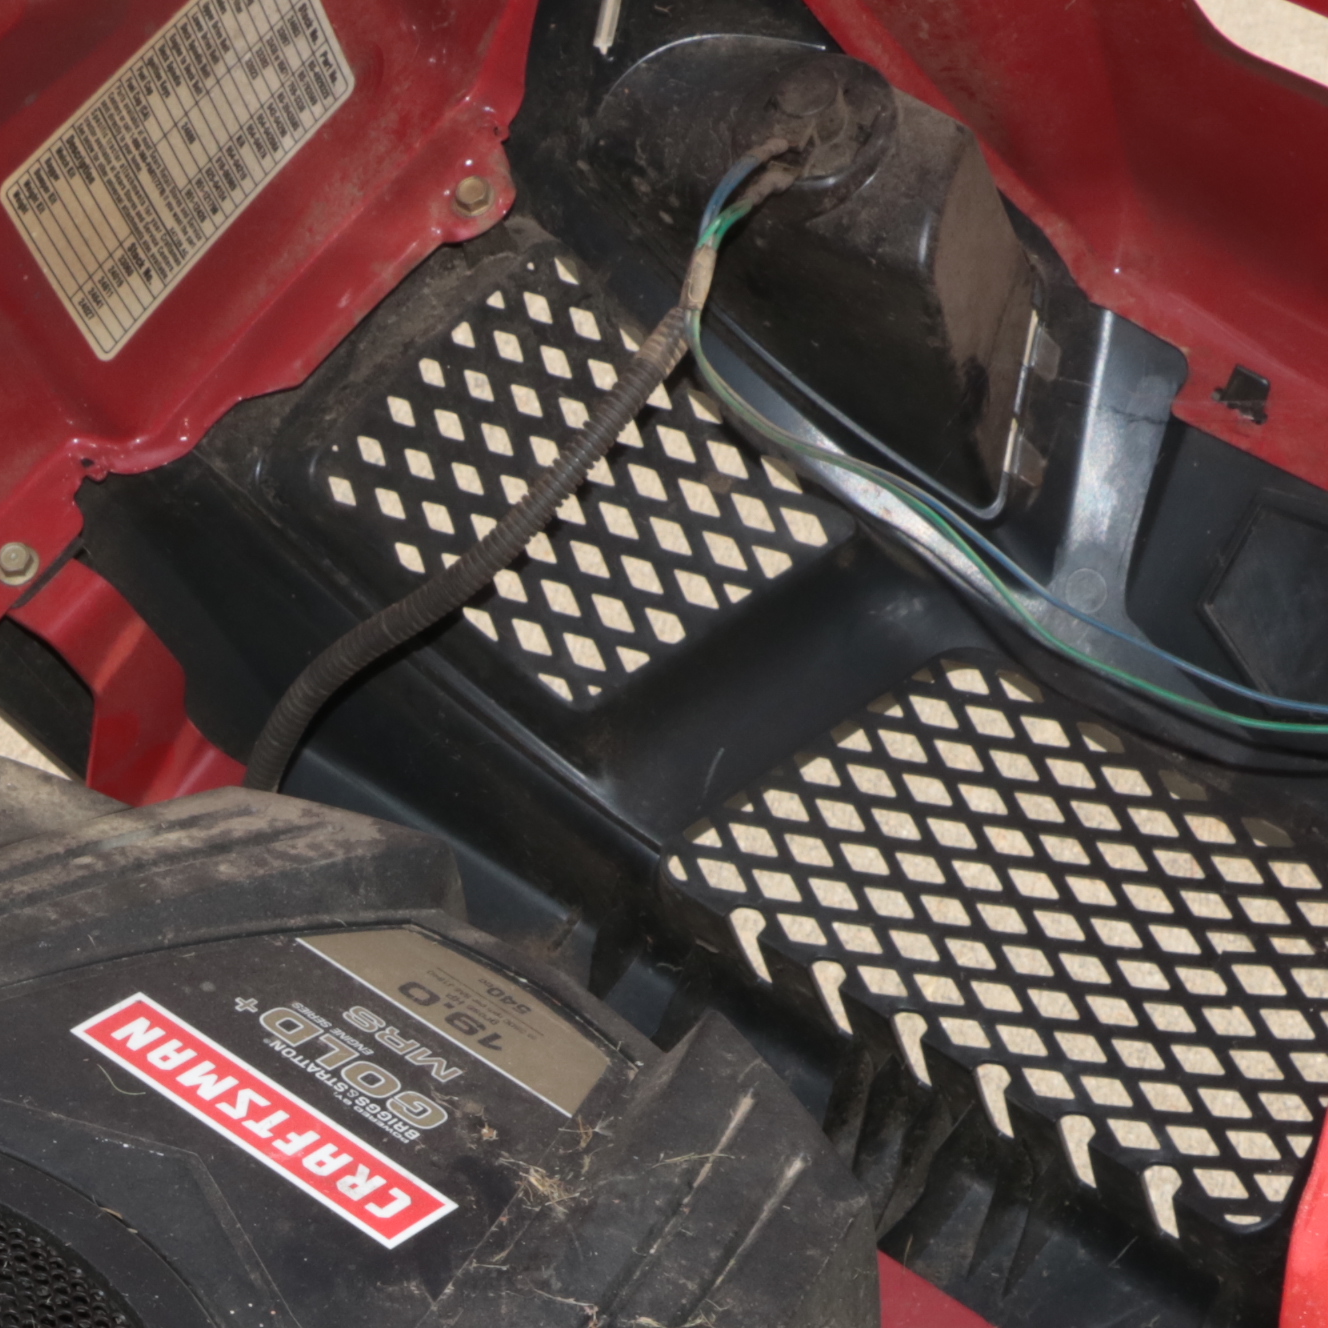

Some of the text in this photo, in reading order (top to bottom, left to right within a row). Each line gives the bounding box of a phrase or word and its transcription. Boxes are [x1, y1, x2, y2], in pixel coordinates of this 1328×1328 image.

[190, 10, 221, 66] Lower Drive Belt
[211, 19, 225, 40] Drive
[219, 36, 231, 54] Belt
[297, 1, 321, 46] Stock No.
[157, 43, 183, 88] Deck Spindle
[167, 32, 185, 59] Engine
[183, 62, 196, 82] Deck
[191, 79, 203, 97] Belt
[179, 21, 212, 80] Deck Spindle Belt
[319, 49, 333, 72] Part
[124, 75, 137, 94] Fuel
[130, 90, 144, 108] Cap
[135, 64, 155, 97] Fuel Cap
[144, 54, 172, 100] Ignition Keys
[100, 98, 111, 114] sent
[105, 111, 123, 137] directly
[42, 156, 62, 183] Bagger
[53, 145, 76, 180] Mulch Kit
[63, 133, 98, 186] Description
[107, 91, 124, 116] Centers
[122, 120, 132, 135] call
[164, 199, 175, 214] you
[171, 210, 183, 227] want
[179, 224, 189, 237] the
[184, 233, 196, 250] part
[114, 83, 127, 103] Parts
[122, 100, 142, 130] available
[149, 149, 163, 170] Sears
[158, 166, 173, 188] Retail
[169, 185, 184, 208] Stores
[180, 205, 190, 219] and
[186, 216, 203, 242] Service
[121, 141, 133, 157] your
[9, 189, 29, 217] Weight
[20, 178, 46, 215] Weight Kit
[46, 191, 58, 206] Kit
[83, 115, 99, 138] tractor
[93, 134, 114, 166] available
[113, 169, 128, 191] Sears
[123, 187, 139, 211] Stores
[135, 207, 146, 223] and
[142, 220, 160, 248] Service
[89, 107, 182, 267] Specific tractor attachments for your Craftsman
[126, 240, 156, 286] Stock No.
[394, 978, 513, 1054] 19.0
[444, 991, 466, 1005] HP
[289, 1000, 375, 1056] ENGINE SERIES
[338, 1003, 464, 1084] MRS
[252, 1001, 454, 1134] GOLD
[108, 1014, 418, 1221] CRAFTSMAN
[351, 1104, 411, 1144] POWERED
